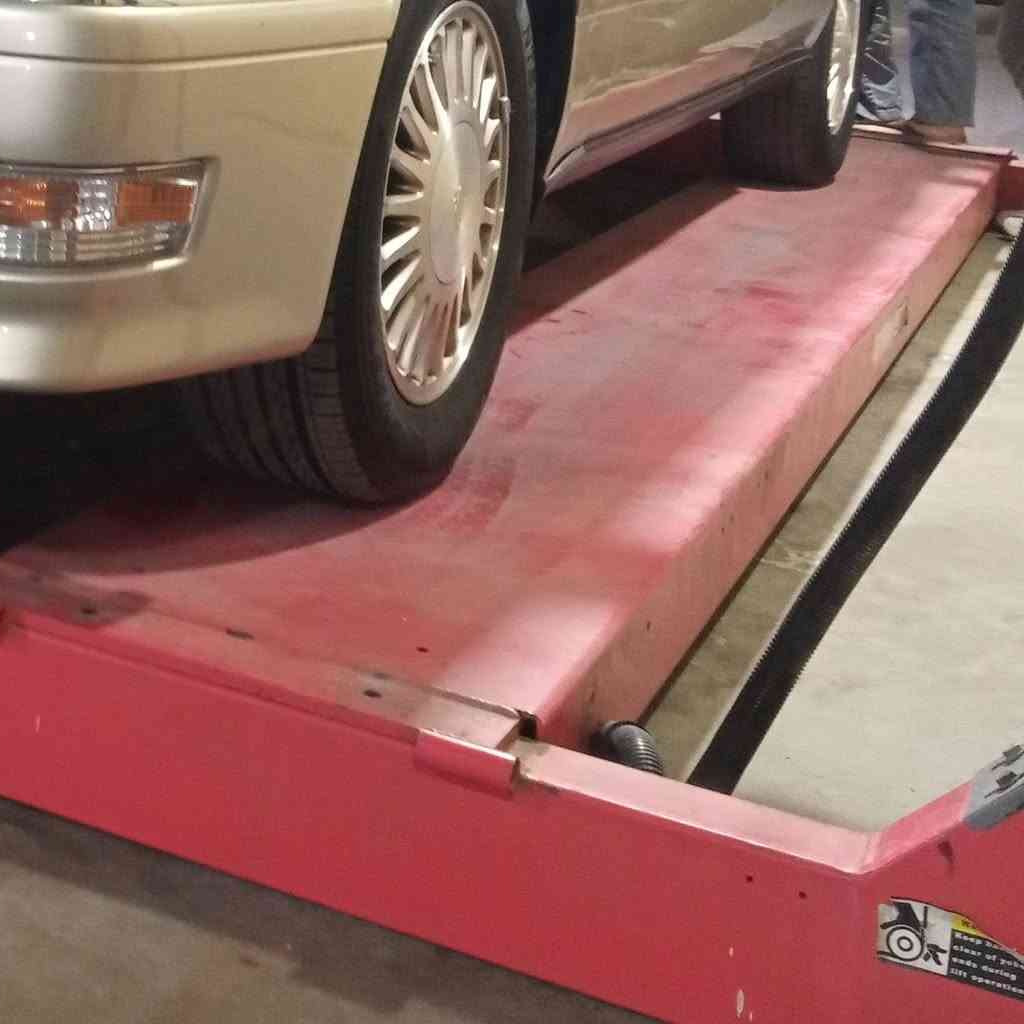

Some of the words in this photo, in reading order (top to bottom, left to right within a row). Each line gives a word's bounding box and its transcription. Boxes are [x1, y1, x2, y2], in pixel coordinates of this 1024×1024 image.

[952, 945, 982, 956] clear
[950, 967, 968, 978] lift
[951, 957, 978, 969] ends
[981, 965, 1017, 981] during
